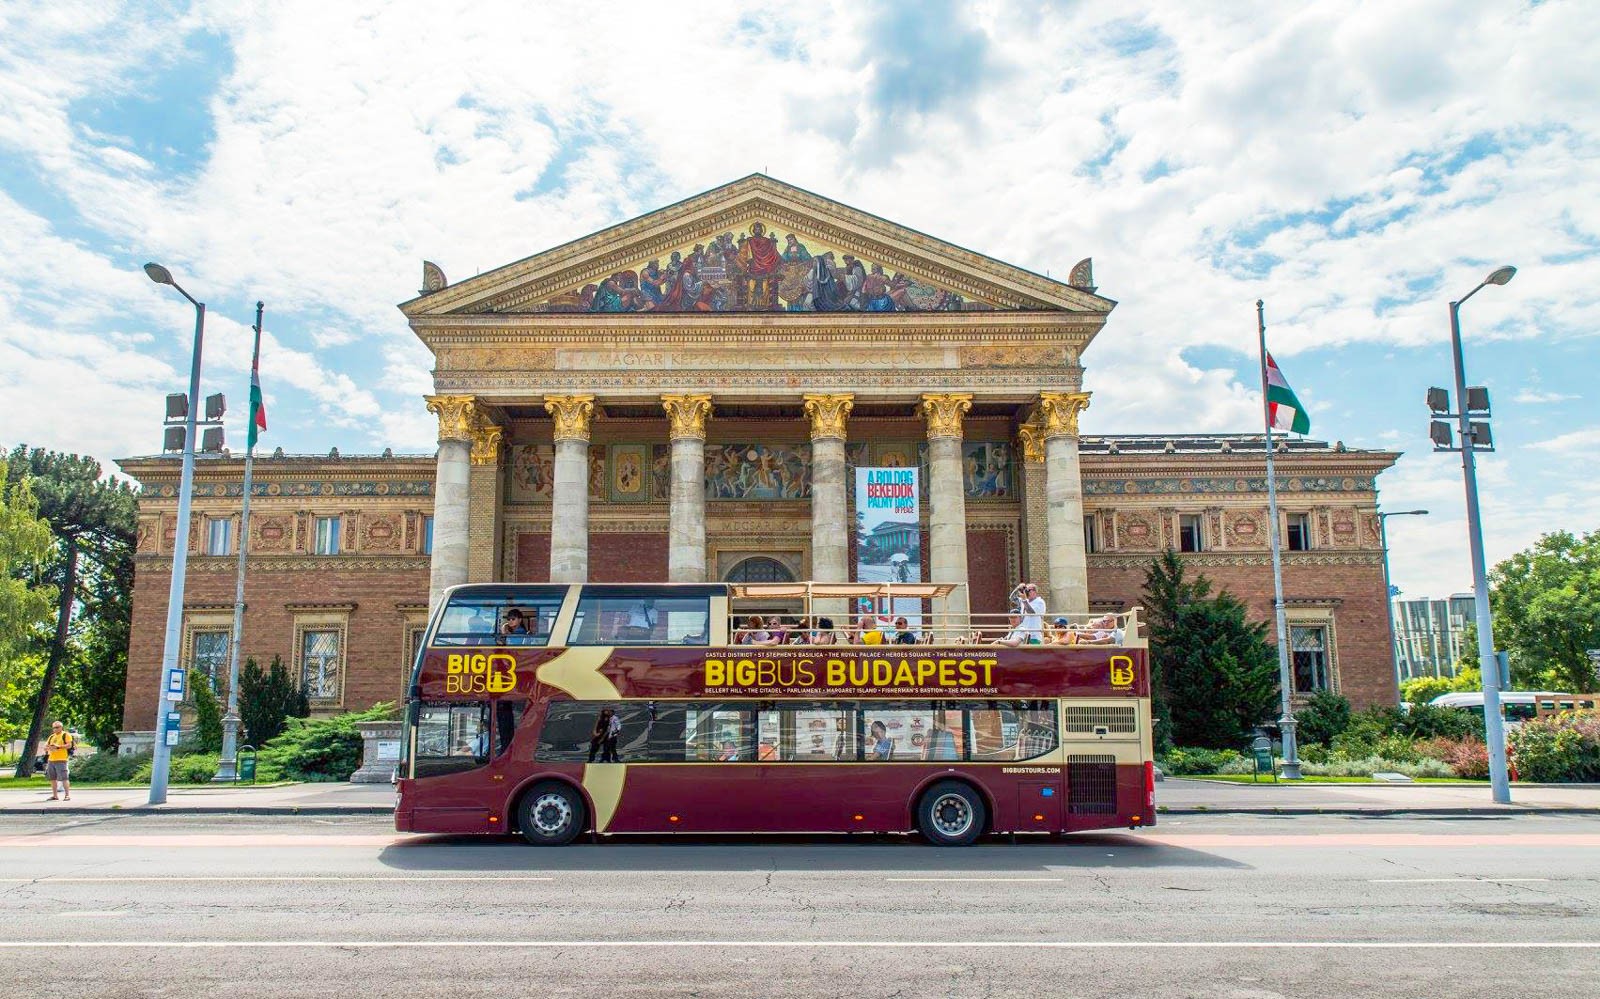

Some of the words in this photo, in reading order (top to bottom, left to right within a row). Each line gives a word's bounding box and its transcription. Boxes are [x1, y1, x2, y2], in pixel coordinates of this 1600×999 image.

[598, 352, 663, 365] MAGYAR
[868, 470, 875, 484] A
[876, 470, 913, 485] BOLDOG
[867, 497, 893, 508] PALMY
[894, 497, 914, 508] DAYS
[447, 654, 487, 674] BIG
[827, 659, 998, 686] BUDAPEST
[446, 674, 486, 693] BUS
